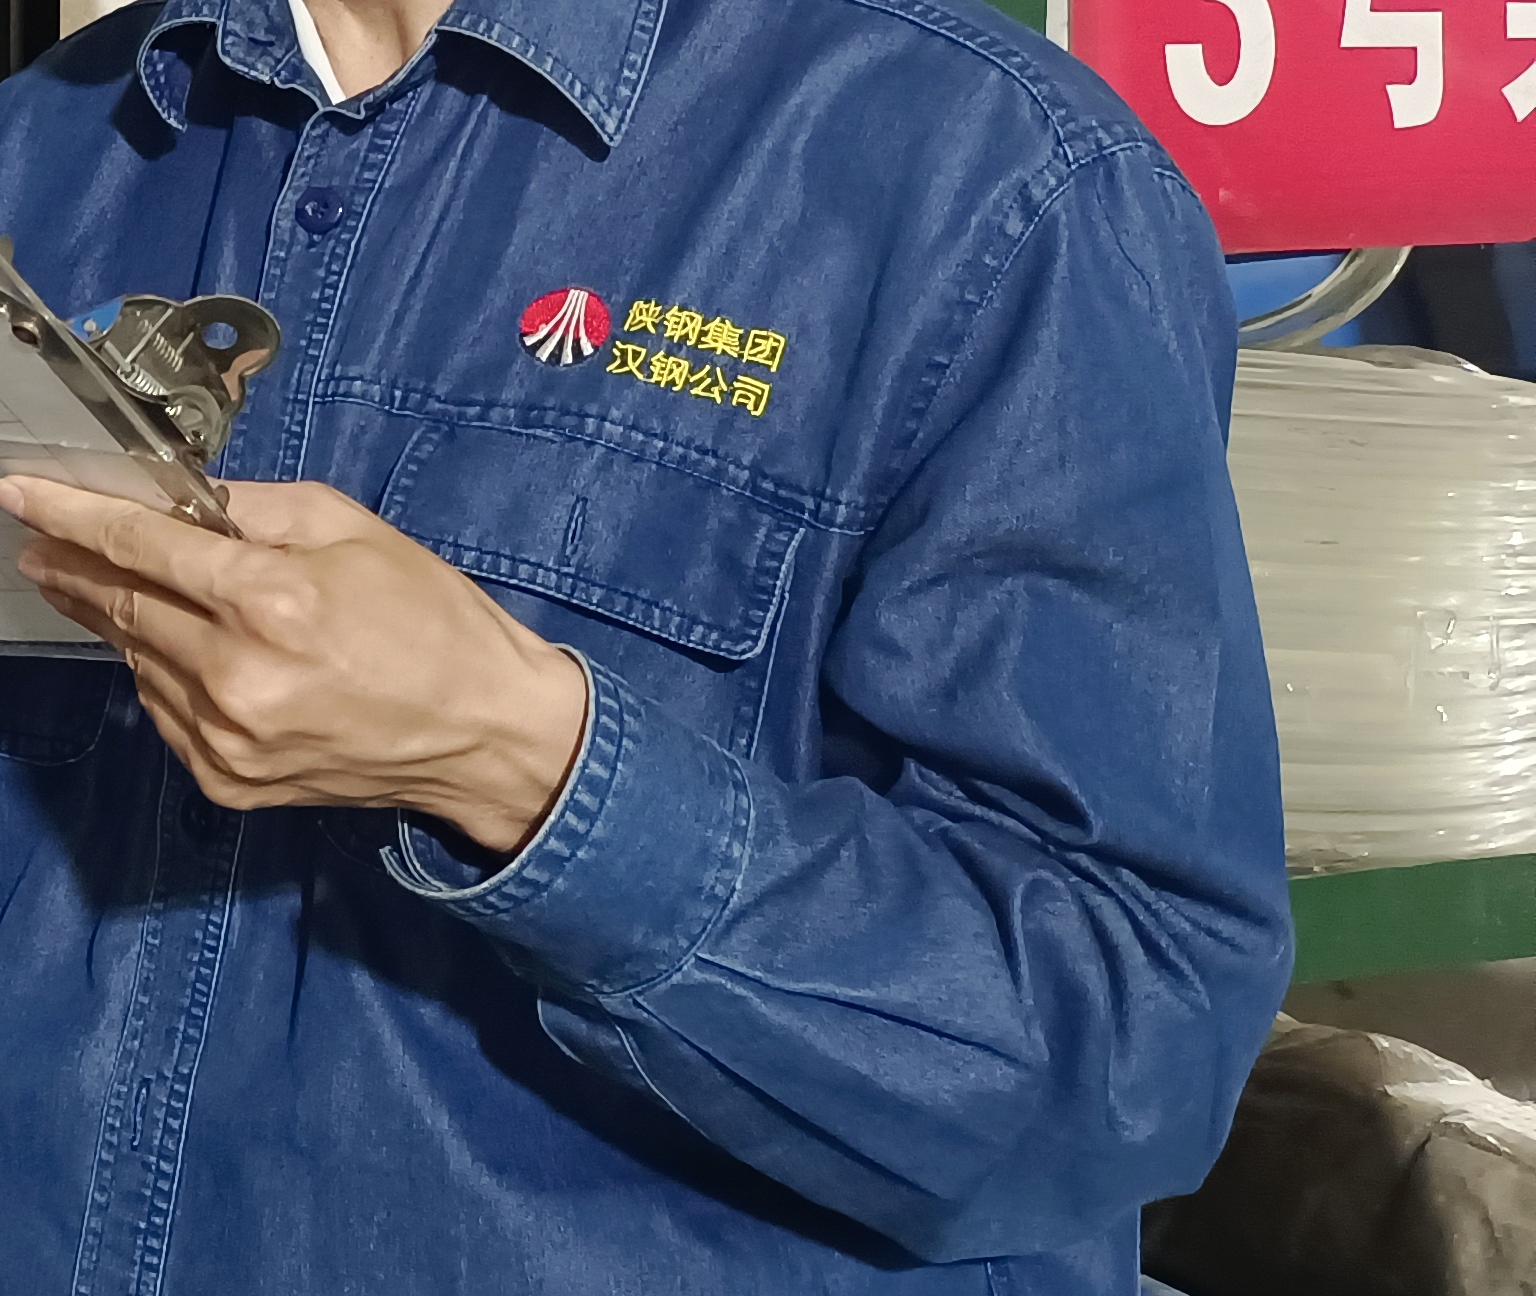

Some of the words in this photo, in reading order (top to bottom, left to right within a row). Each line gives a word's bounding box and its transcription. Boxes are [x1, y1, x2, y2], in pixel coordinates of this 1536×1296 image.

[623, 298, 787, 373] 陕钢集团
[605, 340, 773, 417] 汉钢公司
